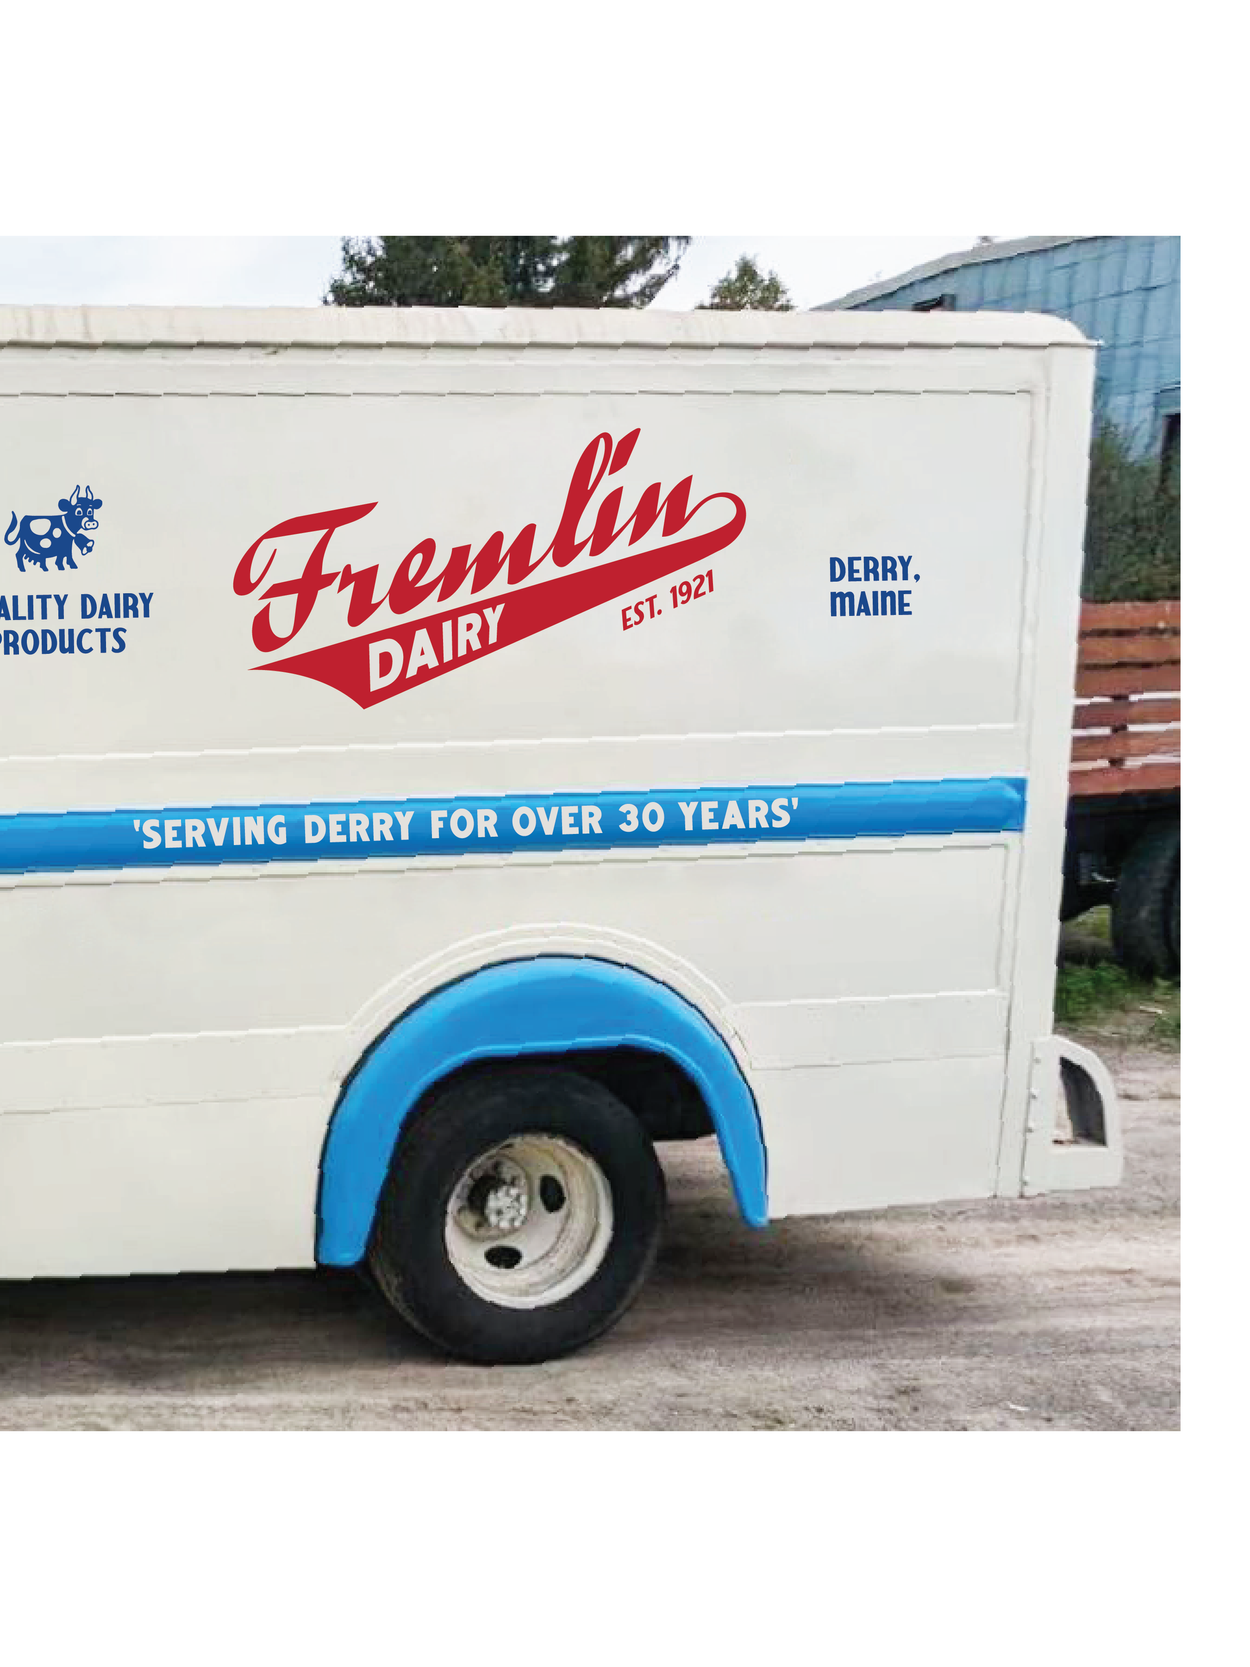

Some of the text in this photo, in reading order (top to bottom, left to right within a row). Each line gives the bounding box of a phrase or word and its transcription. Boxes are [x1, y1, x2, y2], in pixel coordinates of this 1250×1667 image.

[233, 428, 746, 653] Fremlin
[829, 556, 921, 583] DERRY,
[80, 593, 154, 619] DAIRY
[622, 570, 714, 631] EST. 1921
[830, 590, 913, 617] MAINE
[368, 603, 506, 692] DAIRY
[134, 797, 799, 849] 'SERVING DERRY FOR OVER 30 YEARS'
